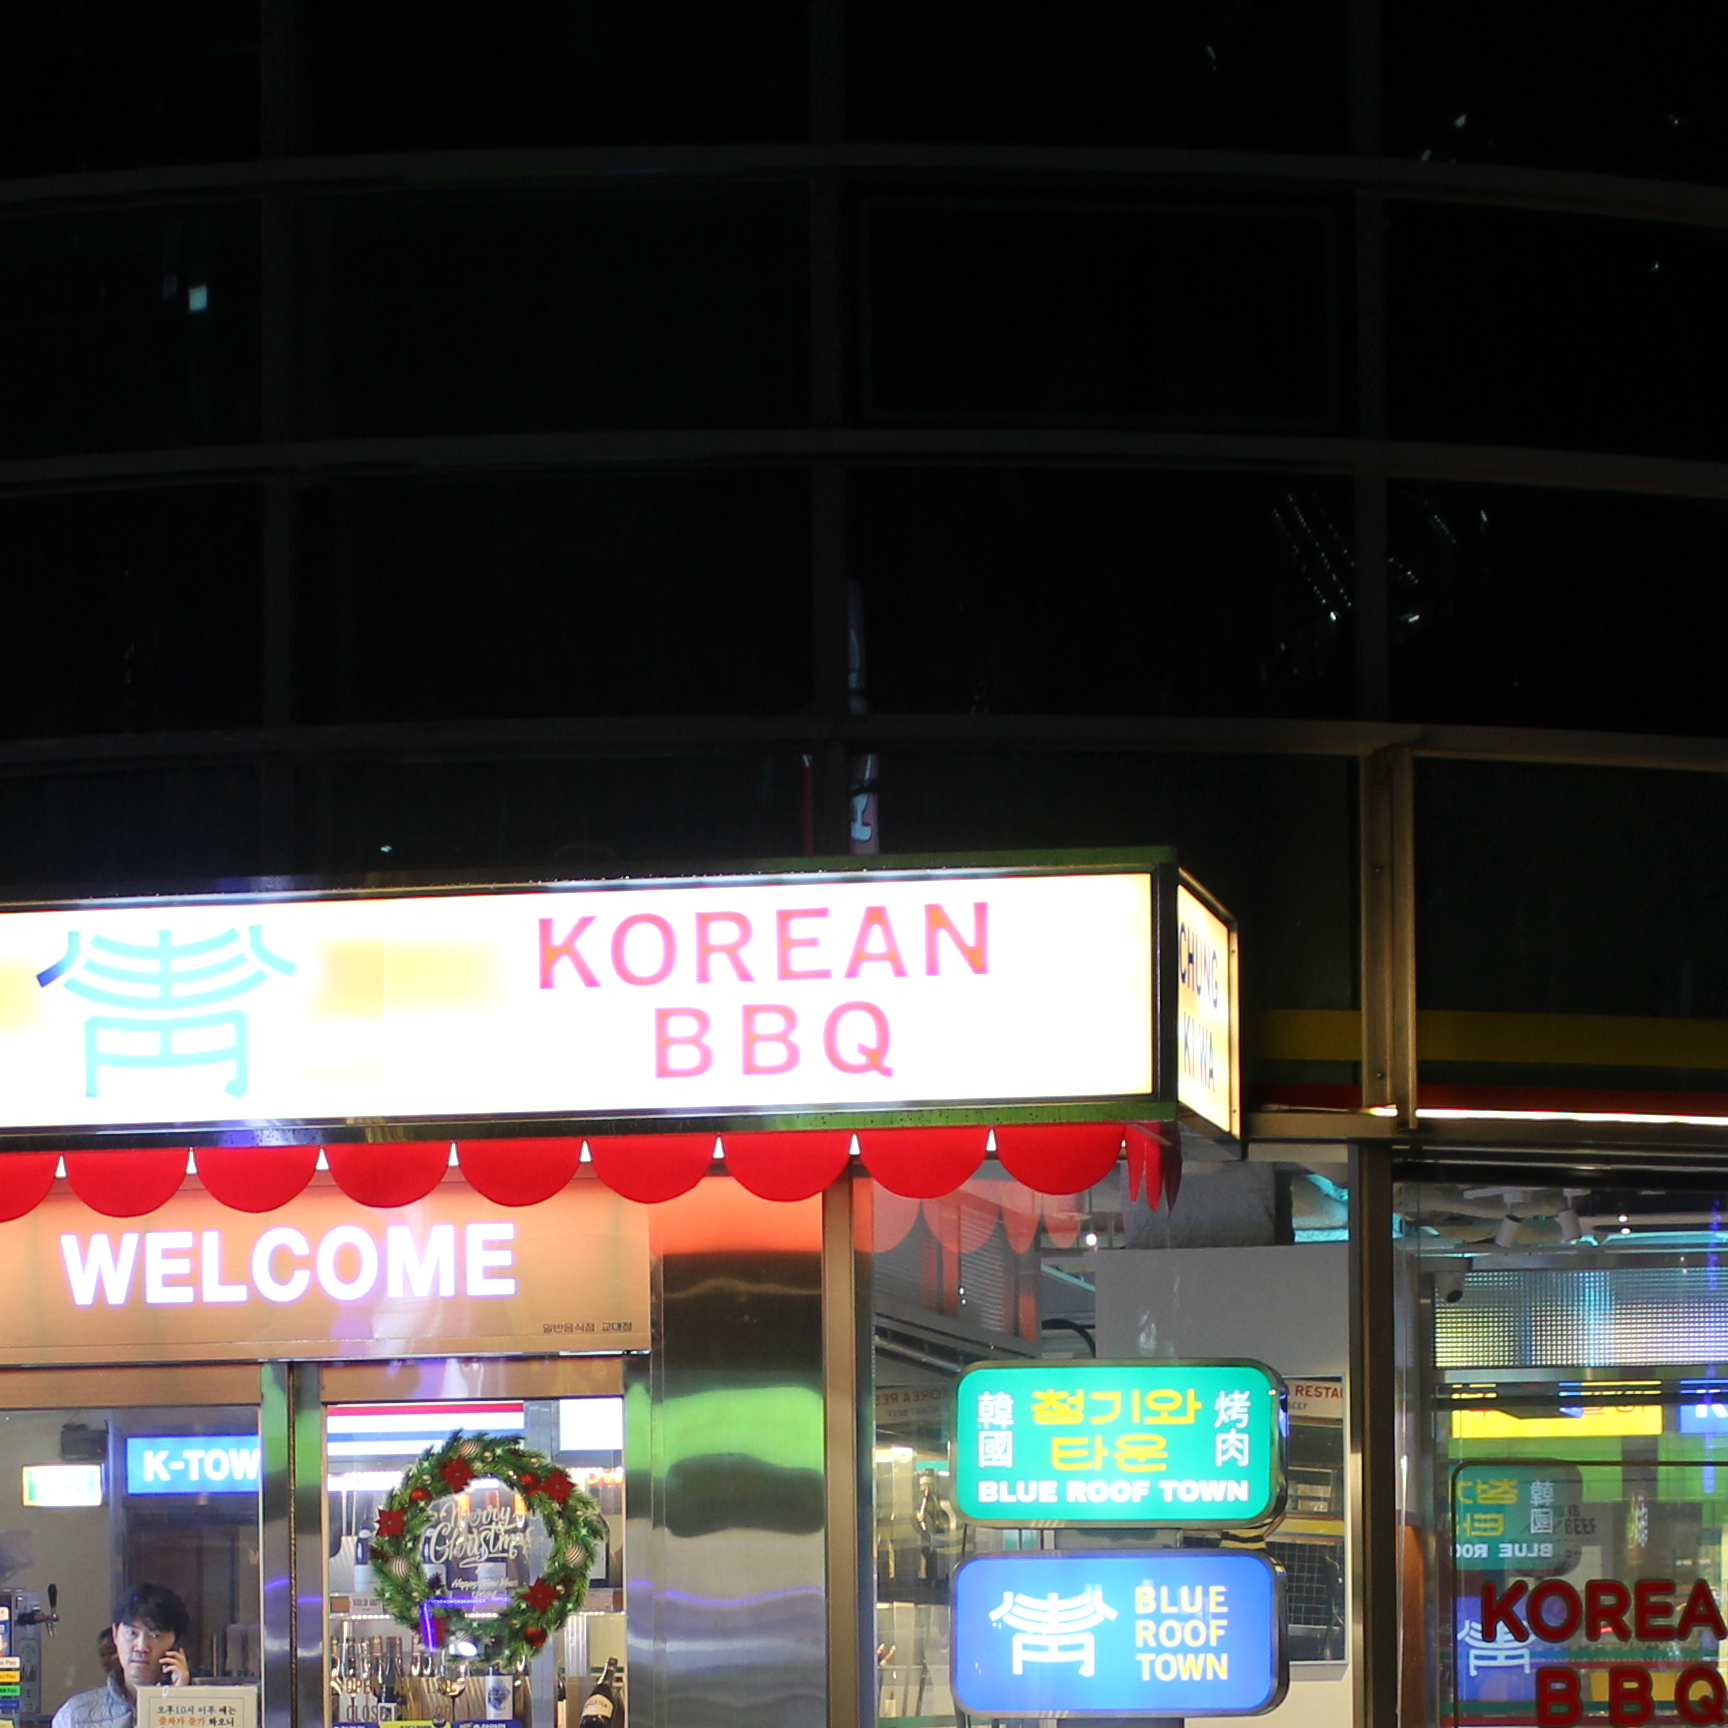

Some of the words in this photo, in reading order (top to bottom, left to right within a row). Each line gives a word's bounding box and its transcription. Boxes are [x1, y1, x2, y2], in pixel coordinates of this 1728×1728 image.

[537, 901, 990, 990] KOREAN
[1180, 922, 1218, 1009] CHUNG
[653, 1000, 894, 1080] BBQ
[1183, 1011, 1195, 1078] KI
[1198, 1023, 1215, 1094] WA
[61, 1223, 517, 1305] WELCOME
[543, 1322, 595, 1333] 일반음식점
[601, 1322, 632, 1332] 교대점
[1030, 1388, 1203, 1425] 청기와
[1295, 1385, 1343, 1398] RESTA
[977, 1390, 1015, 1468] 韓國
[1214, 1390, 1251, 1467] 烤肉
[1050, 1434, 1168, 1472] 타운
[977, 1481, 1058, 1502] BLUE
[1067, 1481, 1151, 1502] ROOF
[1158, 1481, 1249, 1502] TOWN
[1135, 1586, 1229, 1614] BLUE
[1135, 1620, 1228, 1648] ROOF
[1135, 1653, 1229, 1681] TOWN
[157, 1705, 195, 1715] 오후10시
[198, 1705, 215, 1715] 이후
[218, 1706, 237, 1715] 에는
[1536, 1664, 1727, 1728] BBQ
[209, 1717, 234, 1726] 하오니
